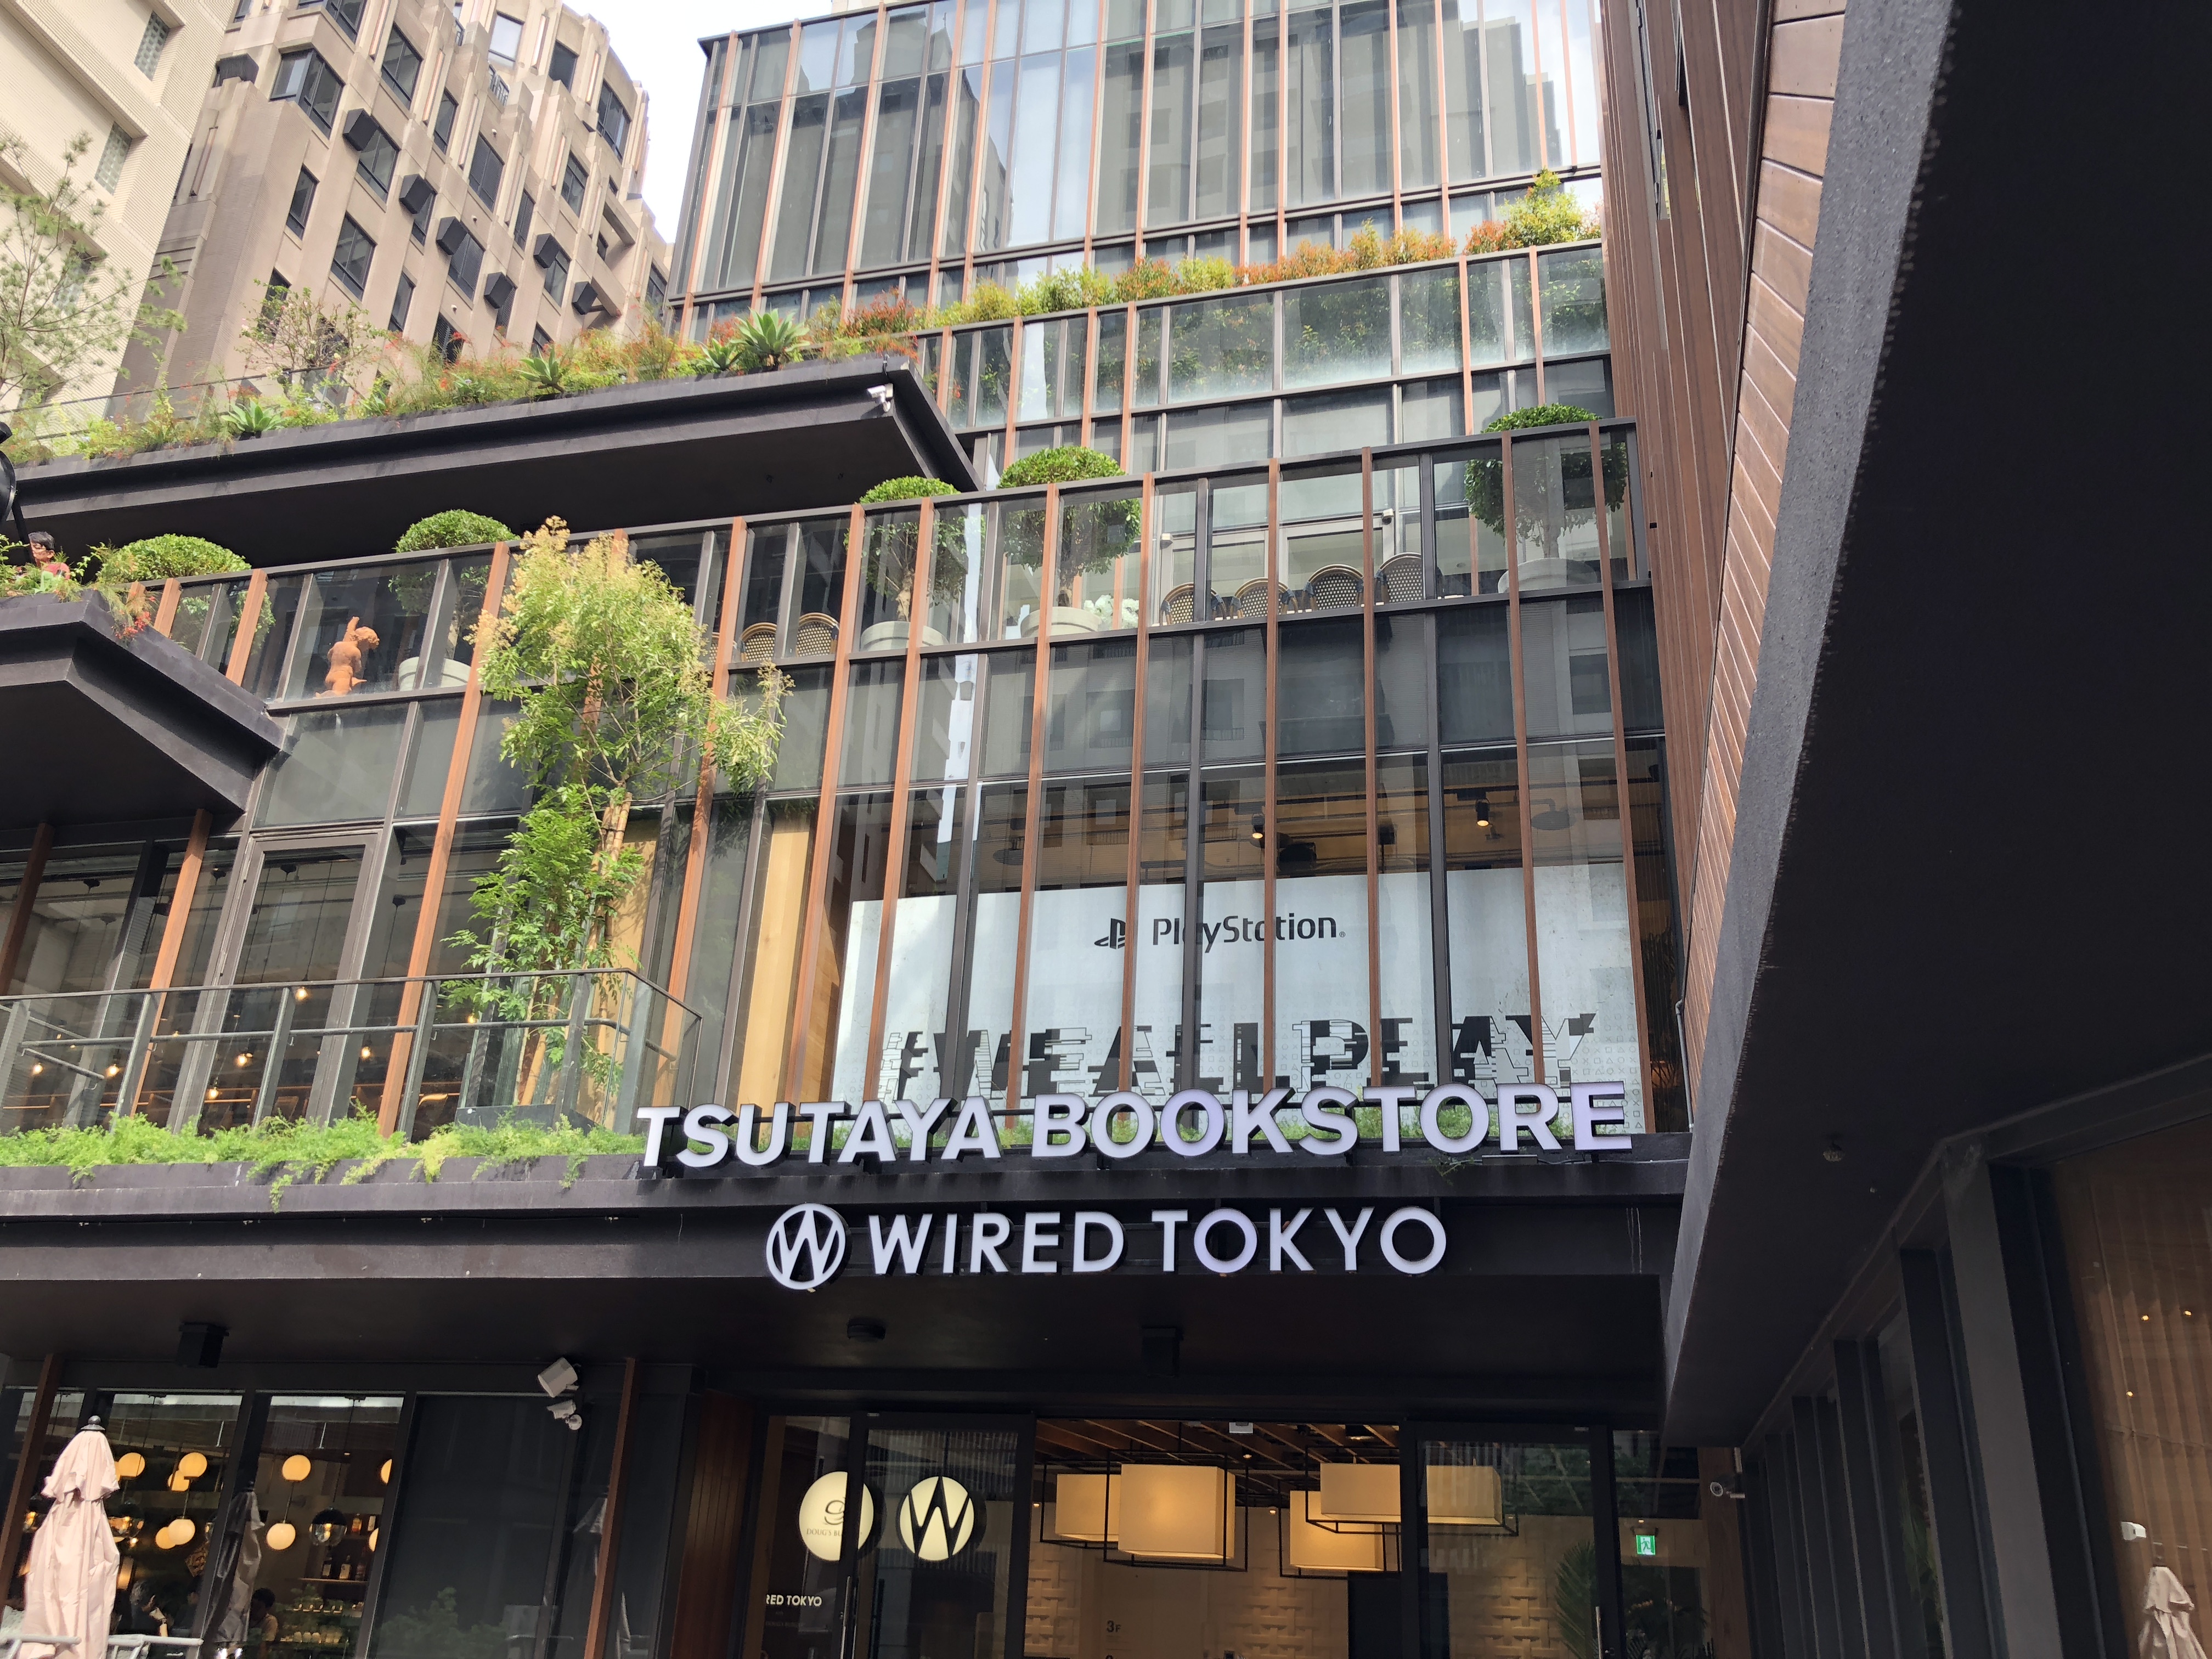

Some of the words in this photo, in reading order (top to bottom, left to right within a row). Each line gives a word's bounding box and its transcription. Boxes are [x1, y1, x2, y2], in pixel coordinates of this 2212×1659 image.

[636, 1097, 1002, 1167] TSUTAYA
[1032, 1081, 1634, 1158] BOOKSTORE
[868, 1211, 1124, 1275] WIRED
[1152, 1207, 1447, 1275] TOKYO
[787, 1595, 822, 1606] TOKYO
[1107, 1620, 1121, 1633] 3F
